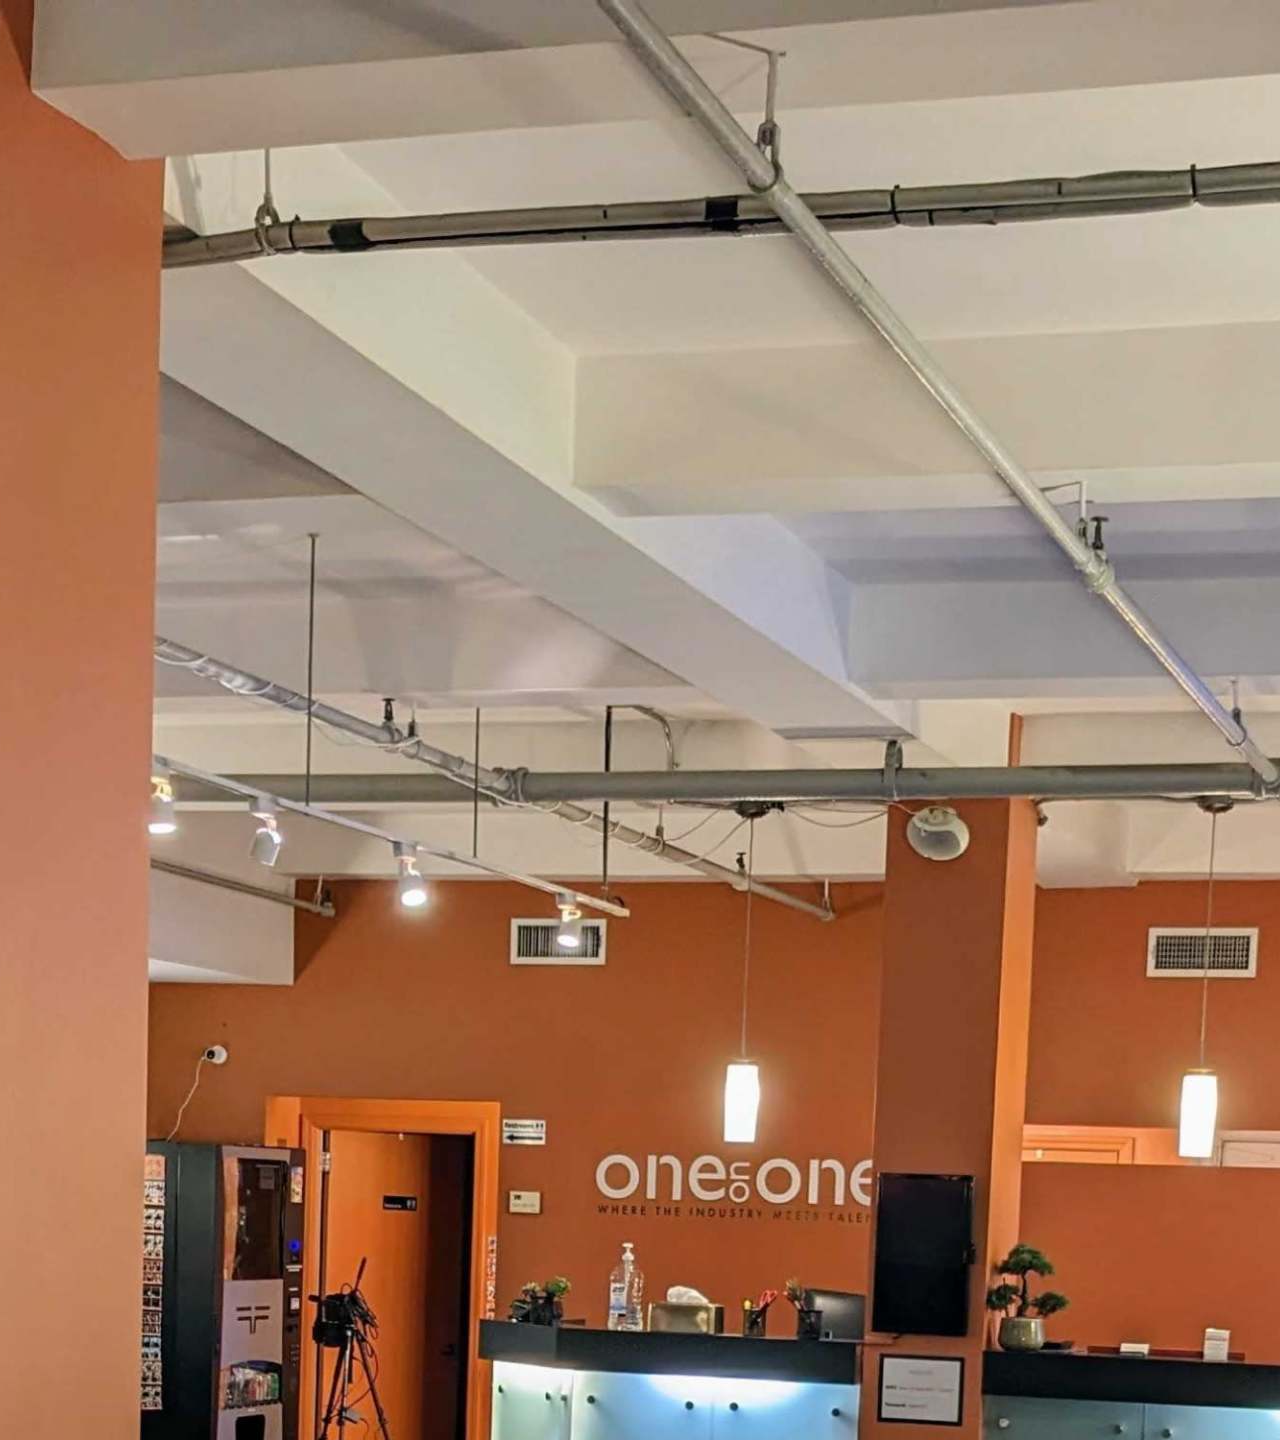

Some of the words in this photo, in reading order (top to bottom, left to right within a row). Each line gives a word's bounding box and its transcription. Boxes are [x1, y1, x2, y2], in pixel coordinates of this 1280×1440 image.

[595, 1154, 727, 1201] one
[755, 1157, 873, 1208] one
[597, 1204, 647, 1217] WHERE
[654, 1206, 681, 1218] THE
[688, 1207, 763, 1221] INDUSTRY
